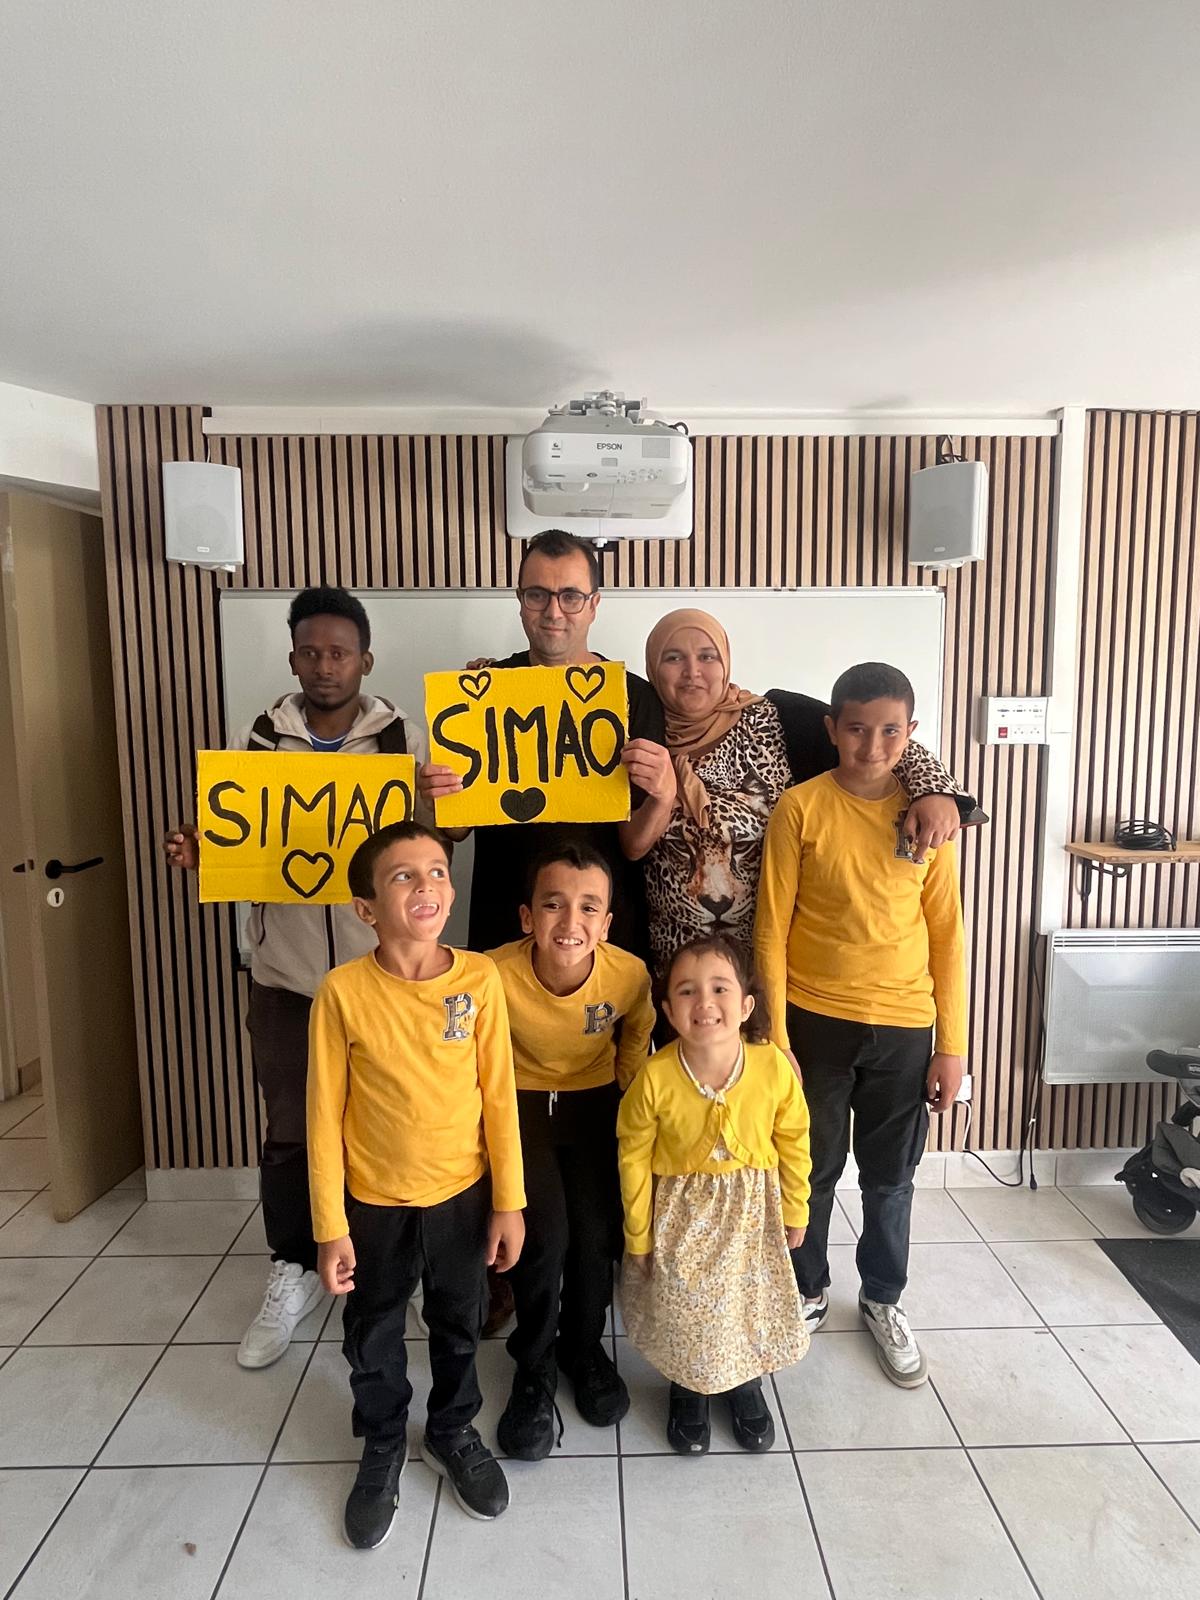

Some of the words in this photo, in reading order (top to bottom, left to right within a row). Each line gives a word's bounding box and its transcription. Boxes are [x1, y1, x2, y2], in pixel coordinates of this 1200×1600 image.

[596, 442, 623, 451] EPSON
[432, 699, 625, 789] SIMAO
[204, 778, 413, 849] SIMAO
